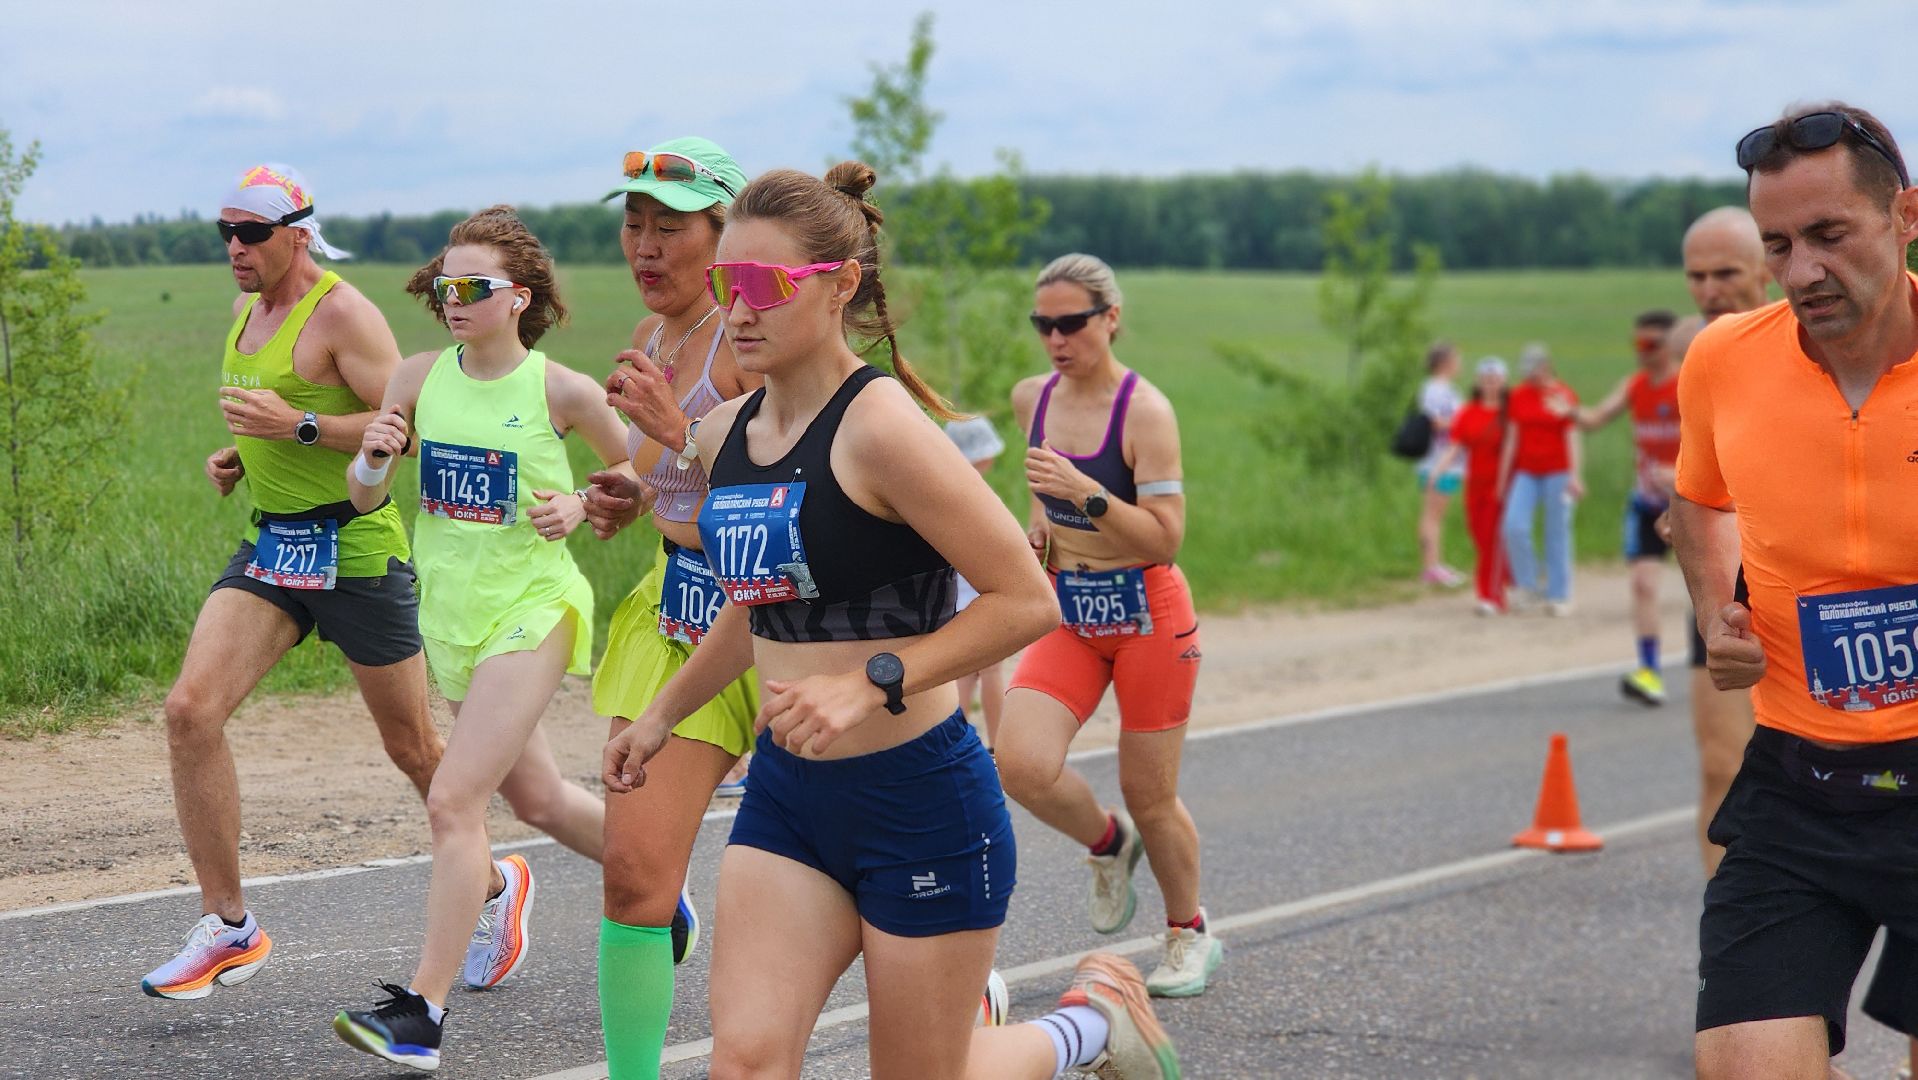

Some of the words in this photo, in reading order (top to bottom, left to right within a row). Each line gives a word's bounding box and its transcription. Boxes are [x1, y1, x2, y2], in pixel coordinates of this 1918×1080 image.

[437, 468, 490, 505] 1143
[274, 543, 318, 573] 1217
[715, 523, 770, 576] 1172
[1072, 594, 1126, 622] 1295
[1819, 603, 1887, 621] ВОЛОКОЛАМСКИЙ
[1833, 625, 1918, 684] 105
